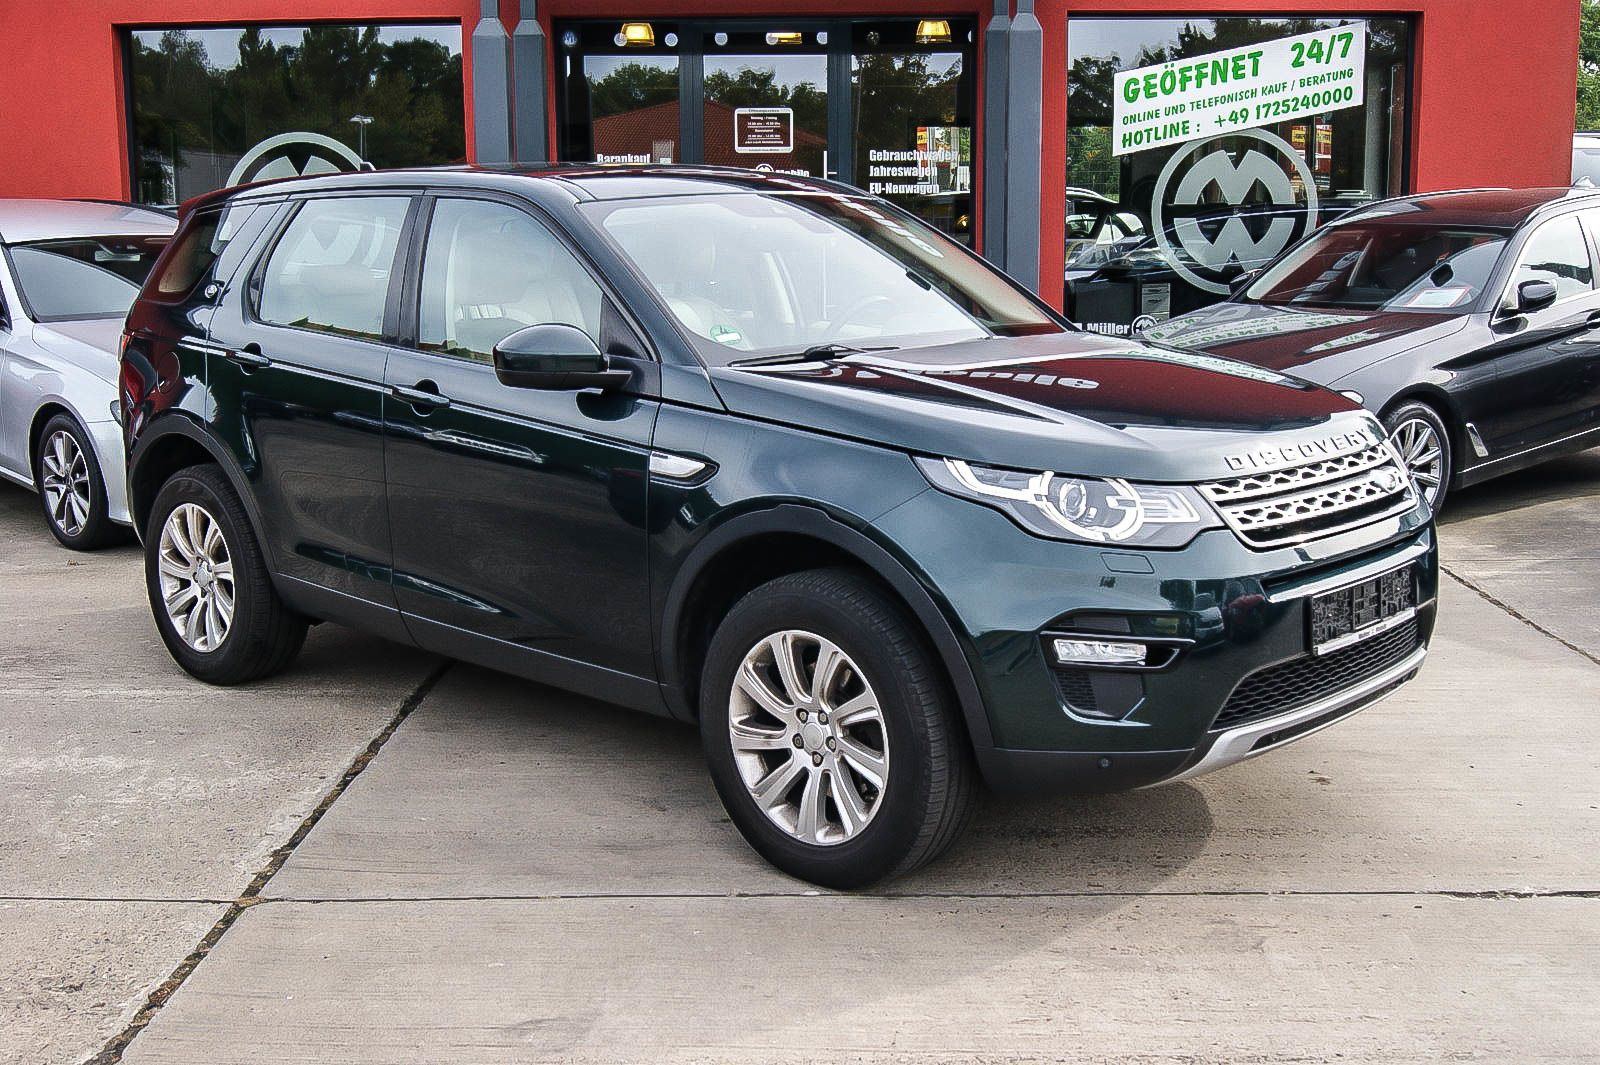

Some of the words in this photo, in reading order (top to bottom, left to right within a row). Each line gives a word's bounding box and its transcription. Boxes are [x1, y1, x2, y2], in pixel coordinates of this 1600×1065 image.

[1123, 50, 1264, 104] GEÖFFNET
[1290, 31, 1354, 69] 24/7
[1121, 120, 1191, 149] HOTLINE
[1214, 107, 1249, 129] +49
[1255, 85, 1353, 120] 1725240000
[1122, 108, 1161, 126] ONLINE
[1164, 104, 1186, 117] UND
[1190, 87, 1258, 112] TELEFONISCH
[1261, 81, 1288, 97] KAUF
[1299, 67, 1354, 89] BERATUNG
[869, 165, 938, 178] Jahreswagen
[869, 182, 940, 195] EU-Neuwagen
[1086, 322, 1130, 335] Müller
[1223, 427, 1370, 472] DISCOVERY
